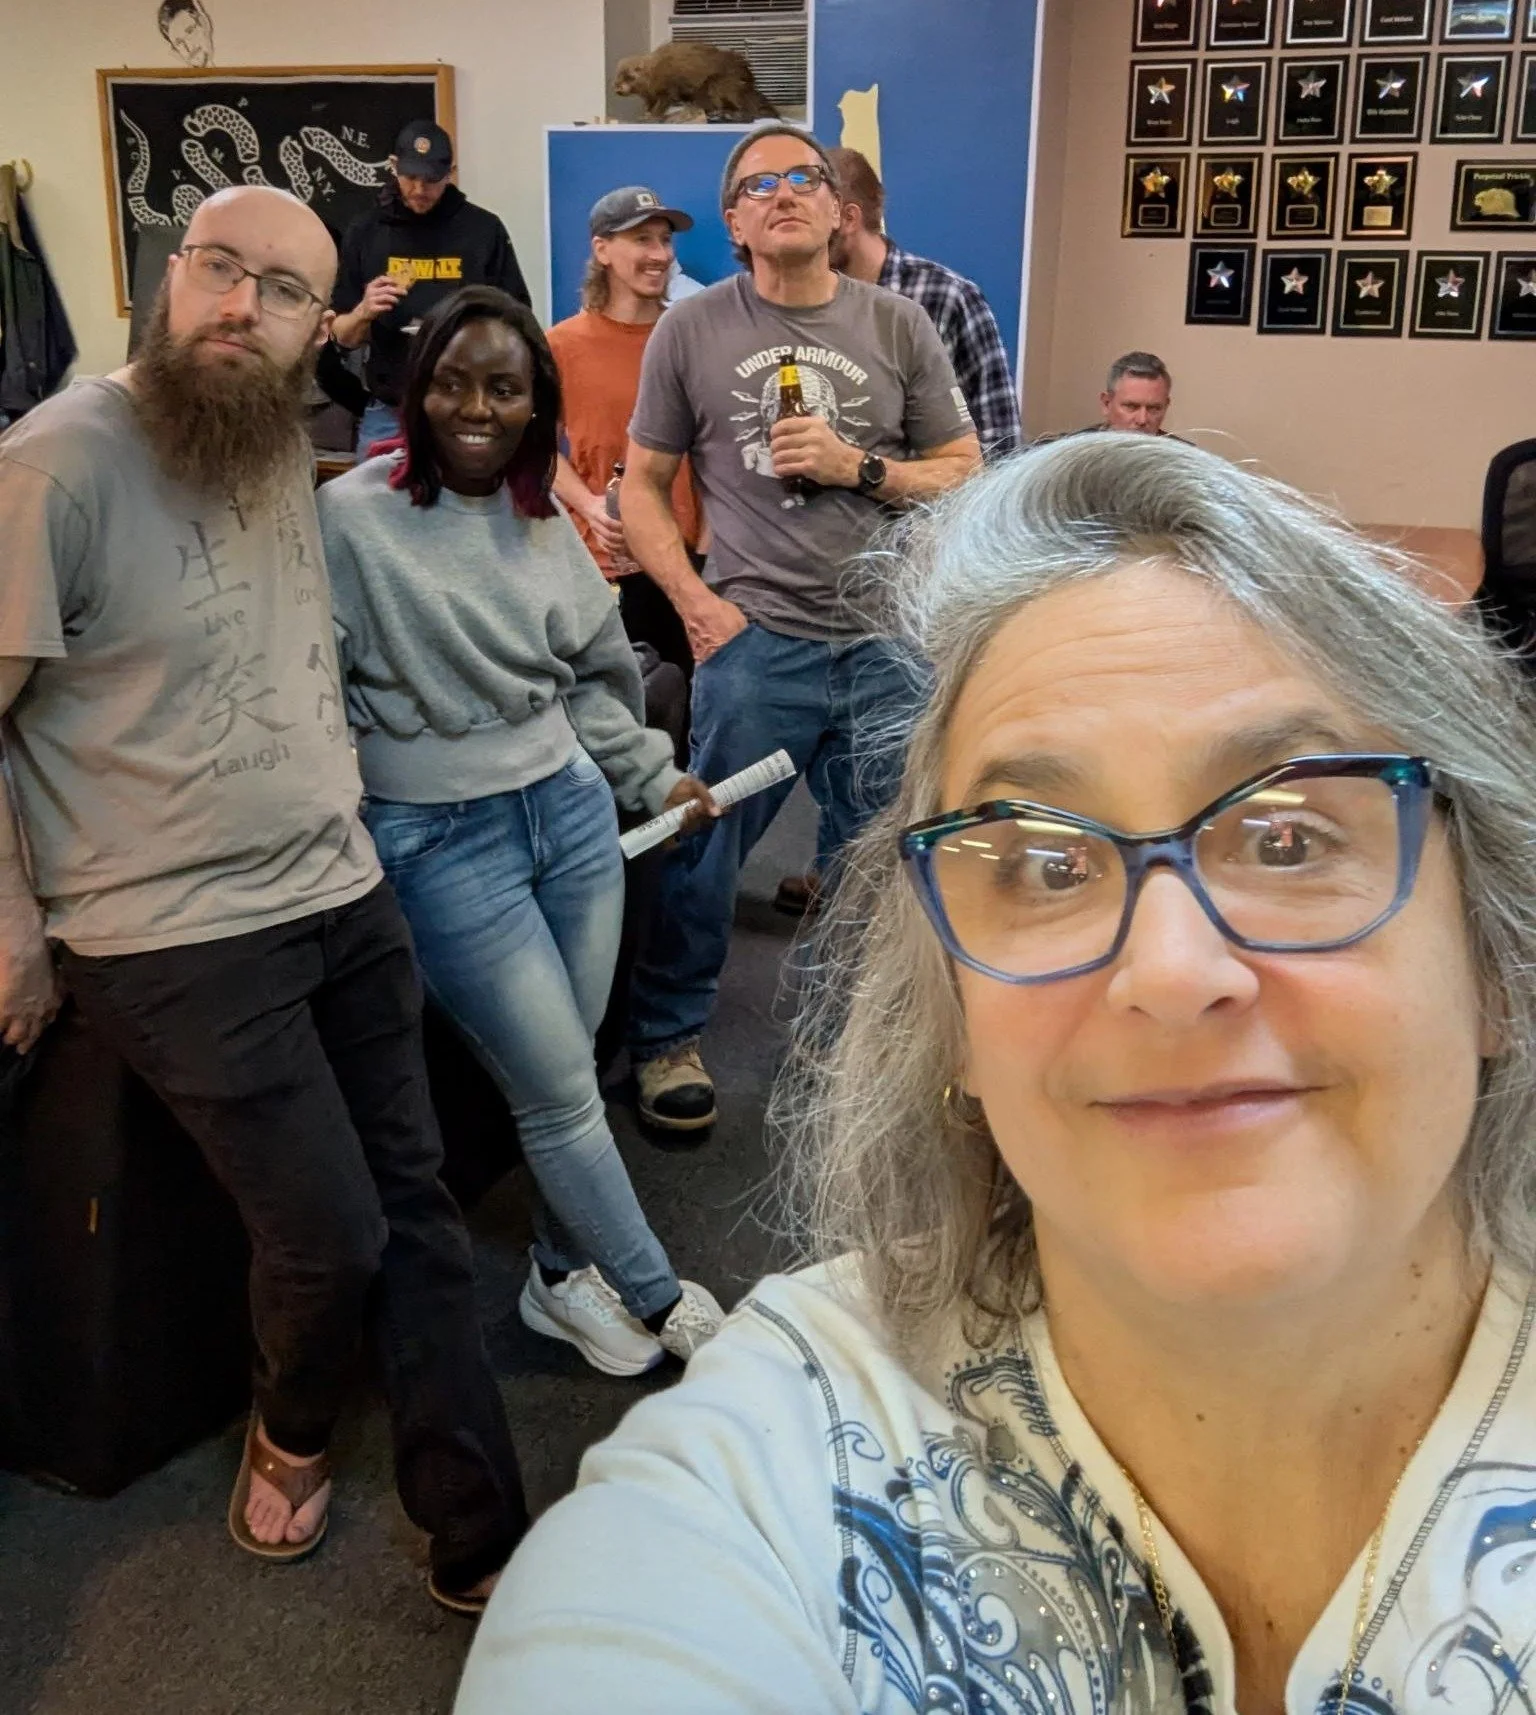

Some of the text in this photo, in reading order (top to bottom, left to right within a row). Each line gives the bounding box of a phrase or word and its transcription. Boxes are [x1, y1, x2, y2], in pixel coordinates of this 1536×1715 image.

[341, 125, 370, 148] N.E.
[311, 166, 337, 202] N.Y.
[387, 257, 463, 280] DWALT
[794, 345, 869, 386] ARMOUR
[210, 738, 291, 778] Laugh
